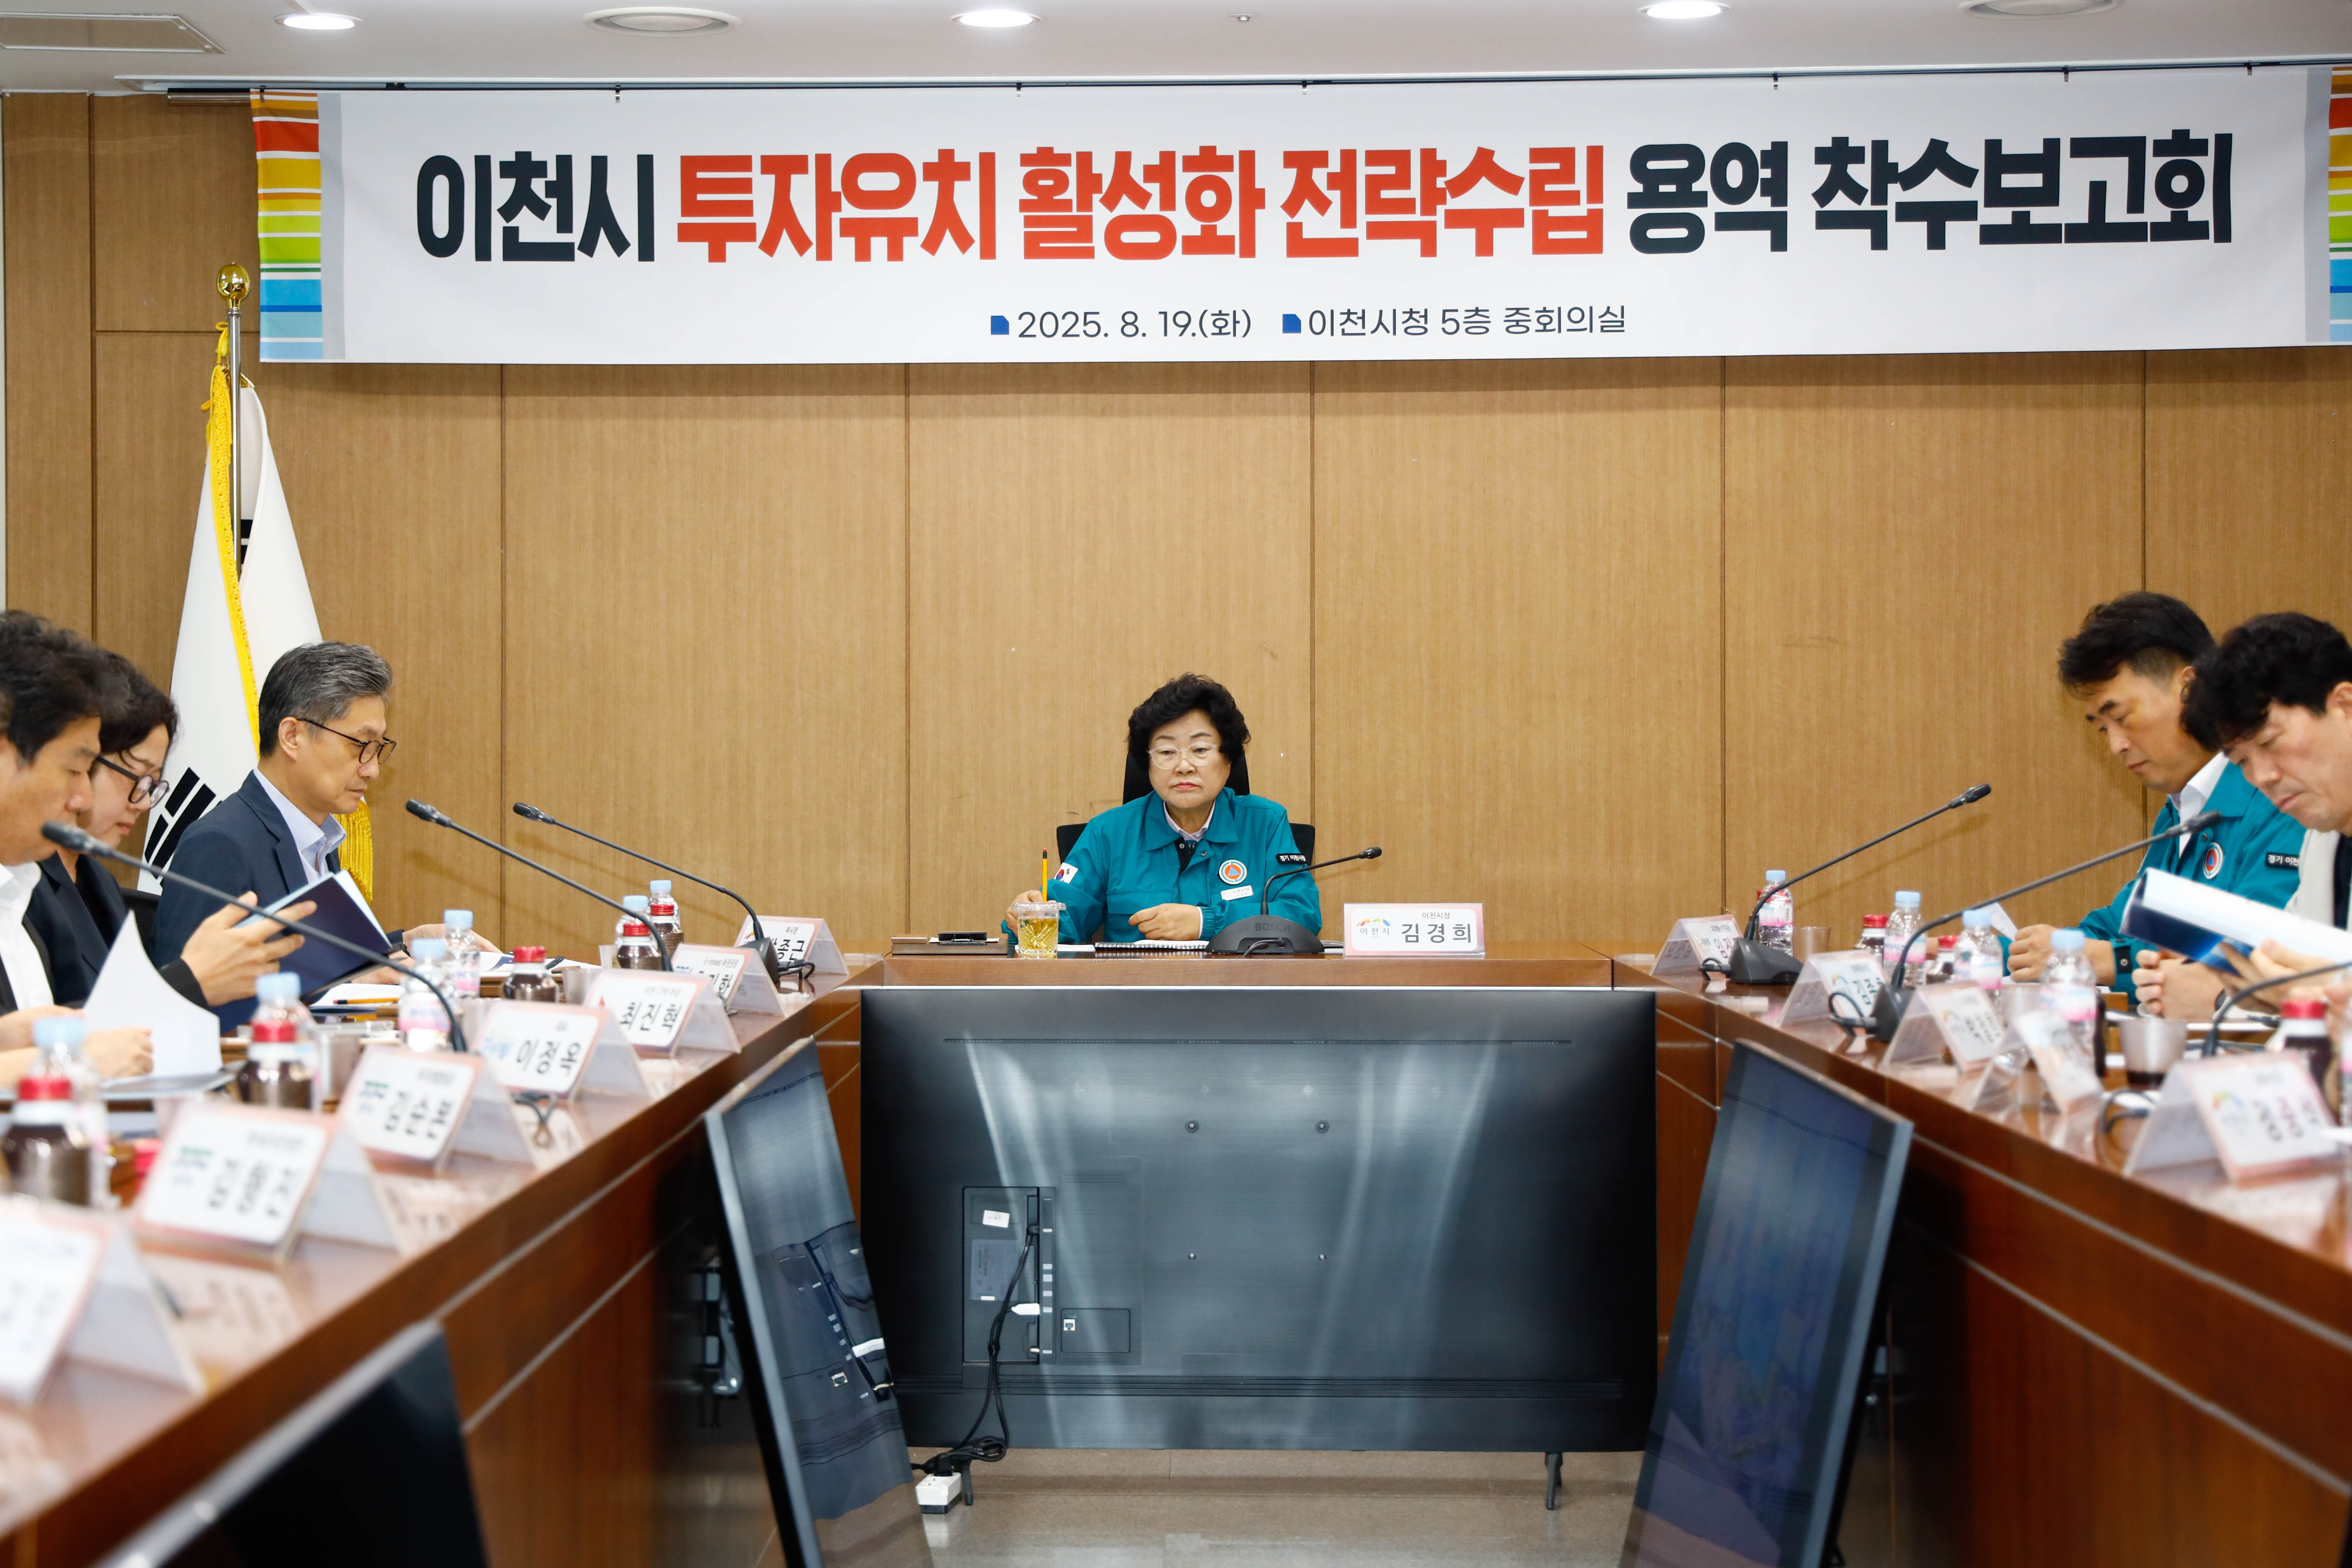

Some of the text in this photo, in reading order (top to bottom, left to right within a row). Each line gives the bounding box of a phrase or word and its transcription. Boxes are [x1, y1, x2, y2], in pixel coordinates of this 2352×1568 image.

[417, 129, 2233, 263] 이천시 투자유치 활성화 전략수립 용역 착수보고회
[1018, 309, 1251, 338] 2025. 8. 19.(화)
[1309, 305, 1625, 336] 이천시청 5층 중회의실
[2268, 855, 2283, 864] 경기
[785, 926, 799, 935] 부시장
[1255, 922, 1291, 932] BOSCH
[1401, 923, 1471, 943] 김경희
[773, 938, 805, 961] 종근
